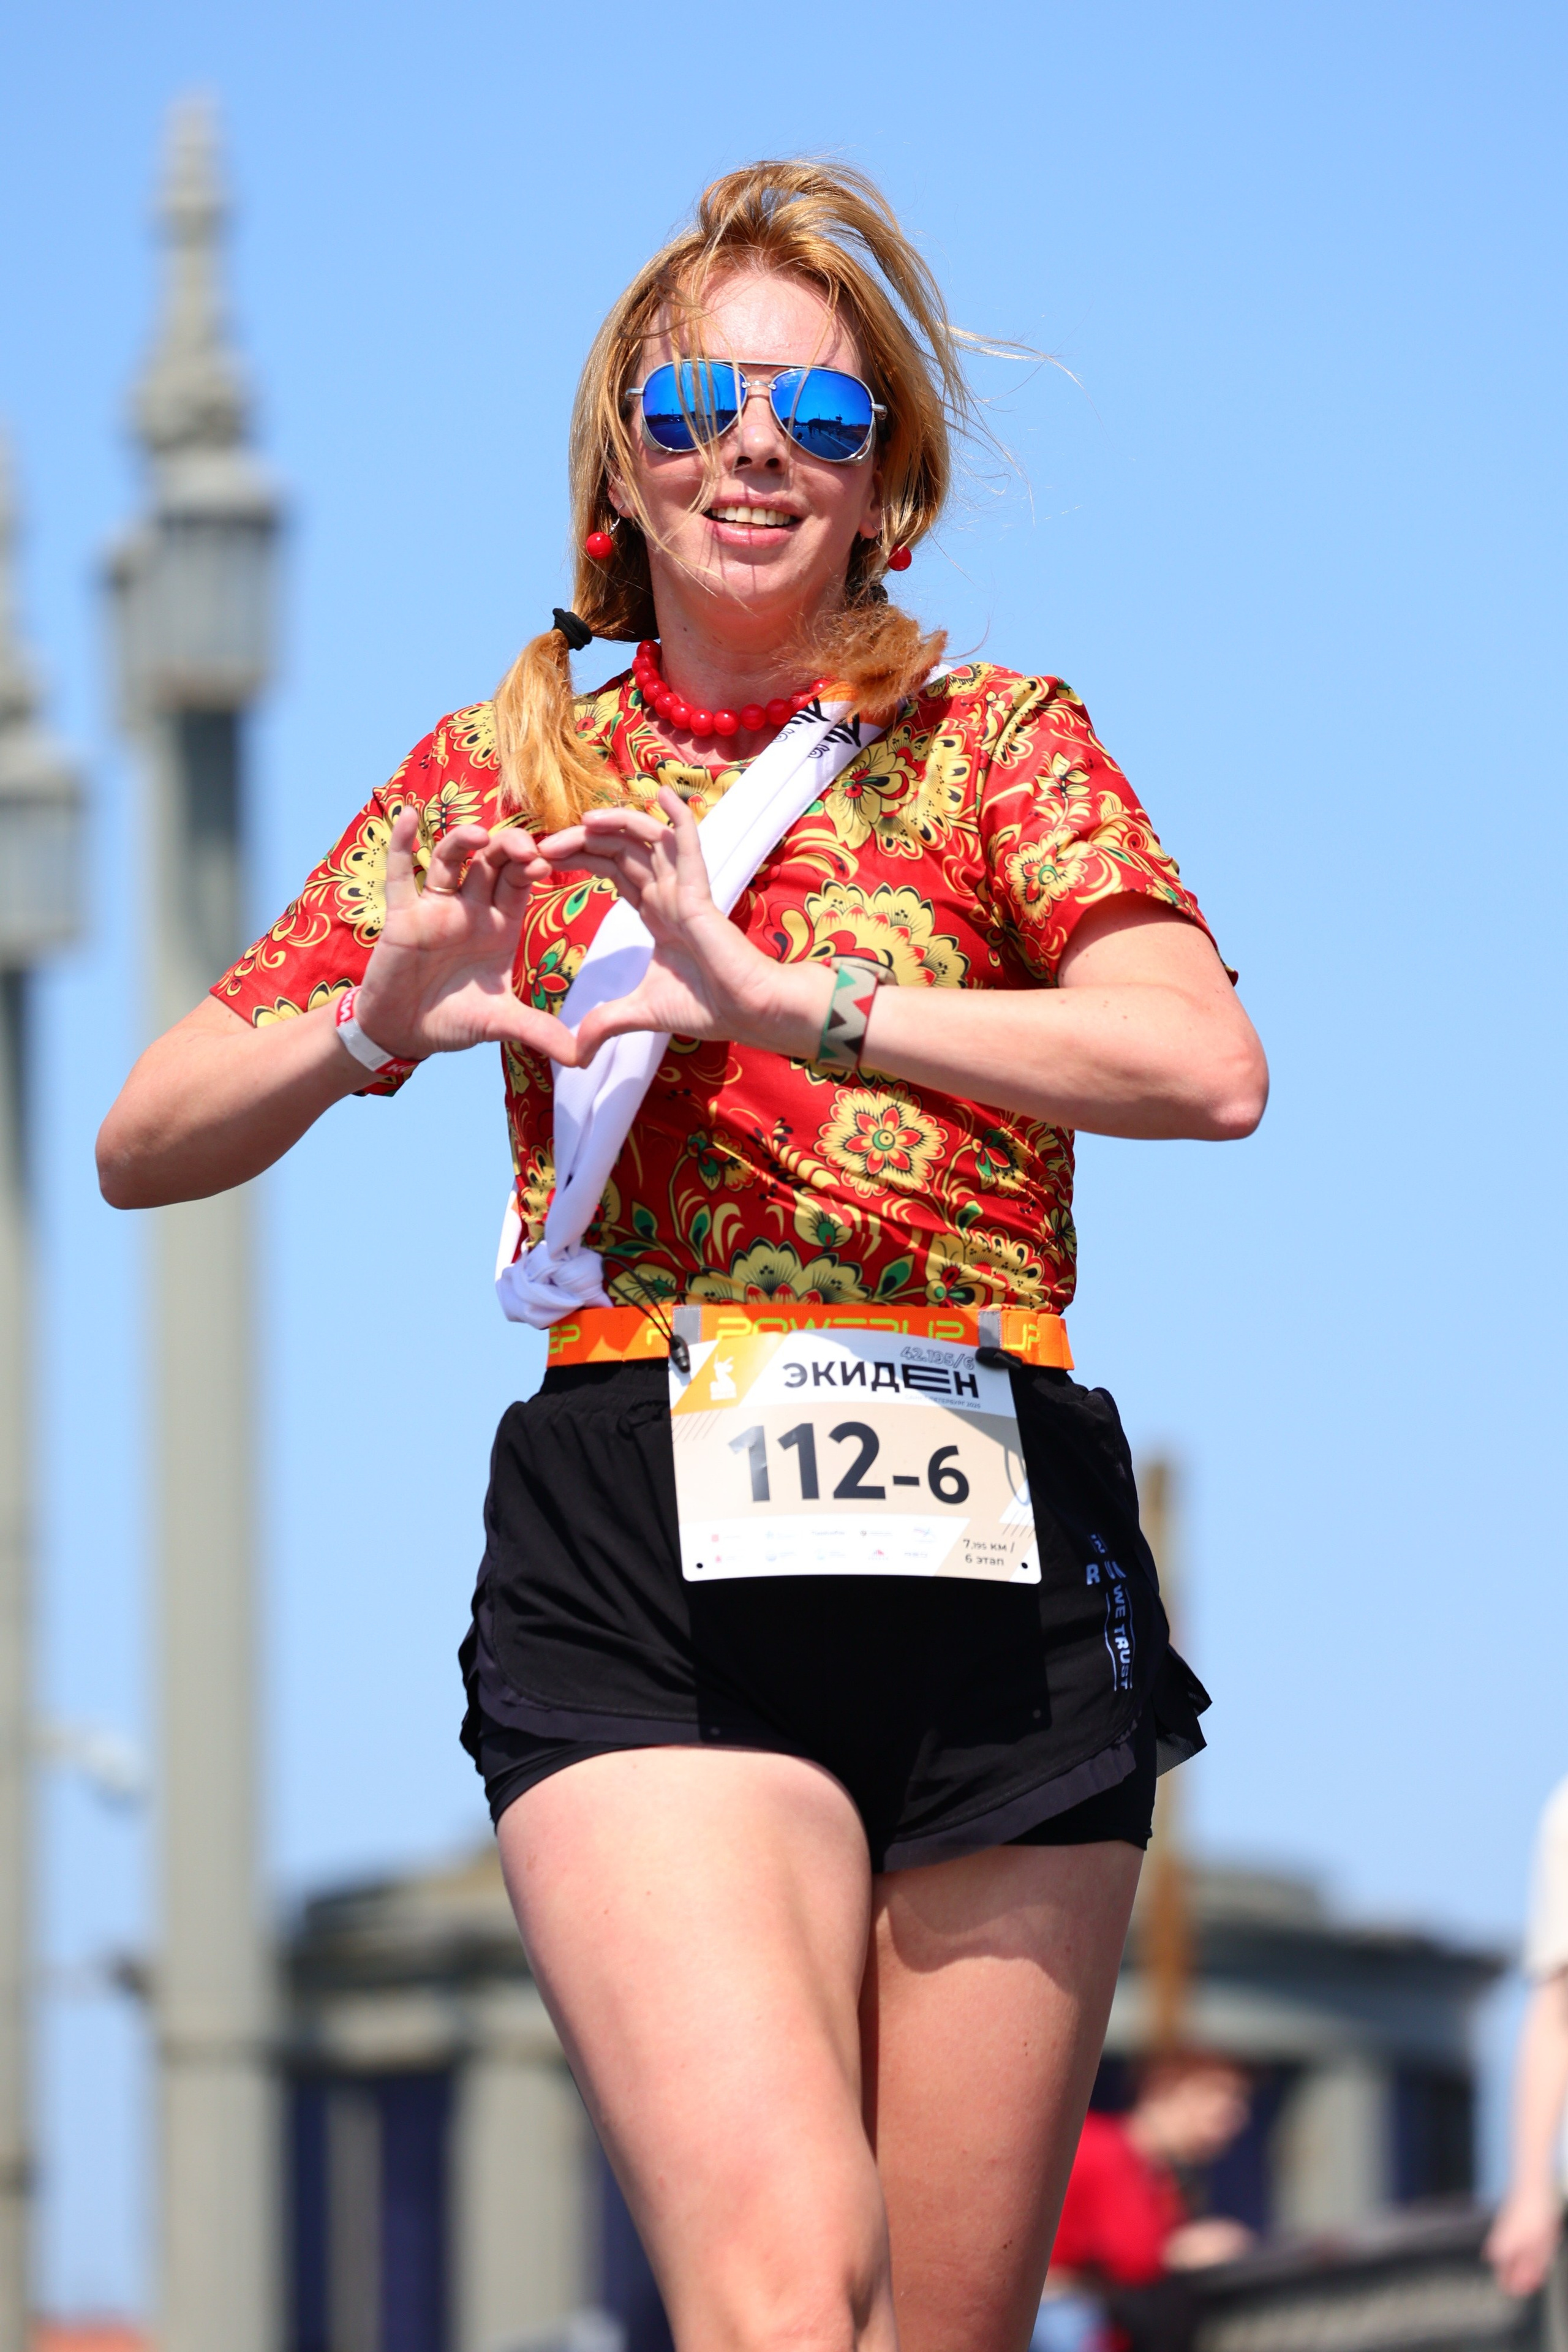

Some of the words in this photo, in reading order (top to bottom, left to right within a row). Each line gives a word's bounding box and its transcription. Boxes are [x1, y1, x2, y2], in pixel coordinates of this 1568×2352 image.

[900, 1346, 976, 1371] 42.195/6
[782, 1361, 979, 1398] ЭКИДЕН
[728, 1420, 970, 1506] 112-6
[965, 1553, 973, 1563] 6
[976, 1556, 1005, 1566] этап
[1112, 1584, 1126, 1619] WE
[1114, 1624, 1131, 1691] TRUST
